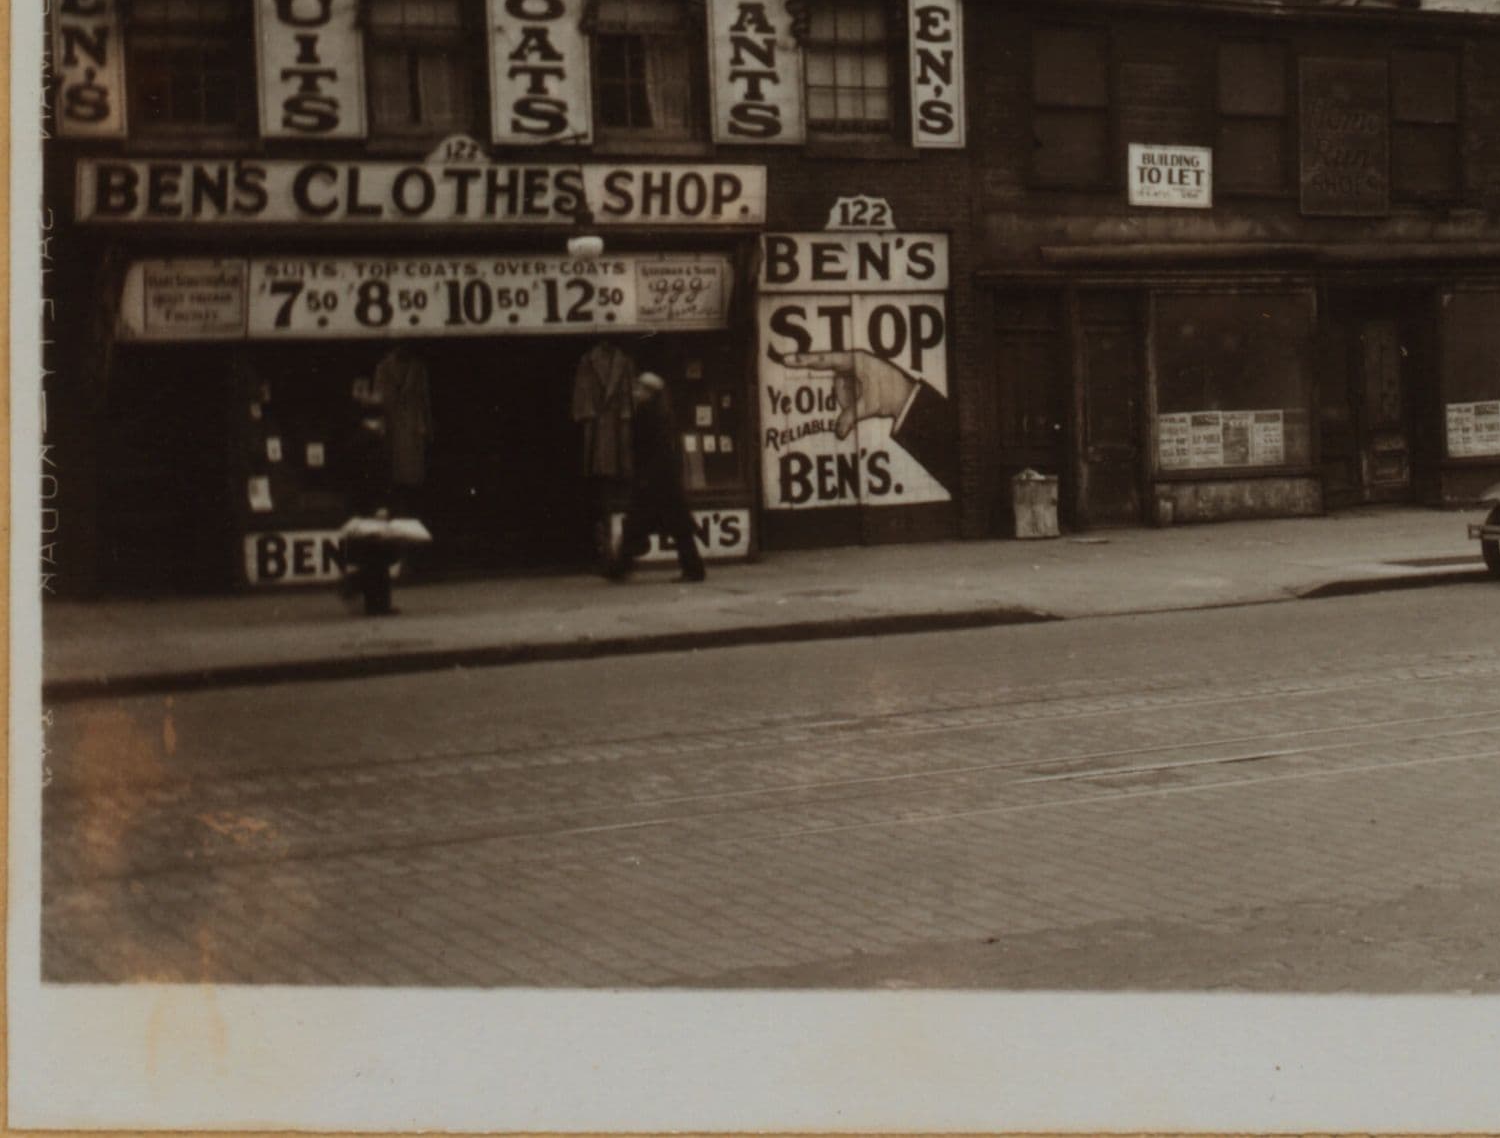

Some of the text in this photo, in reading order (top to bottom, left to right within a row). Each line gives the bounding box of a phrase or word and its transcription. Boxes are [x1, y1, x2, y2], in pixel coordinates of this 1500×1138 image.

[446, 140, 478, 160] 122
[1142, 152, 1201, 168] BUILDING
[292, 164, 584, 218] CLOTHES
[1136, 166, 1206, 187] TO LET
[837, 199, 888, 226] 122
[354, 263, 399, 278] TOP
[764, 235, 937, 285] BEN'S
[766, 303, 945, 373] STOP
[767, 385, 837, 415] Ye Old
[765, 417, 837, 451] RELIABLE
[256, 532, 348, 579] BEN
